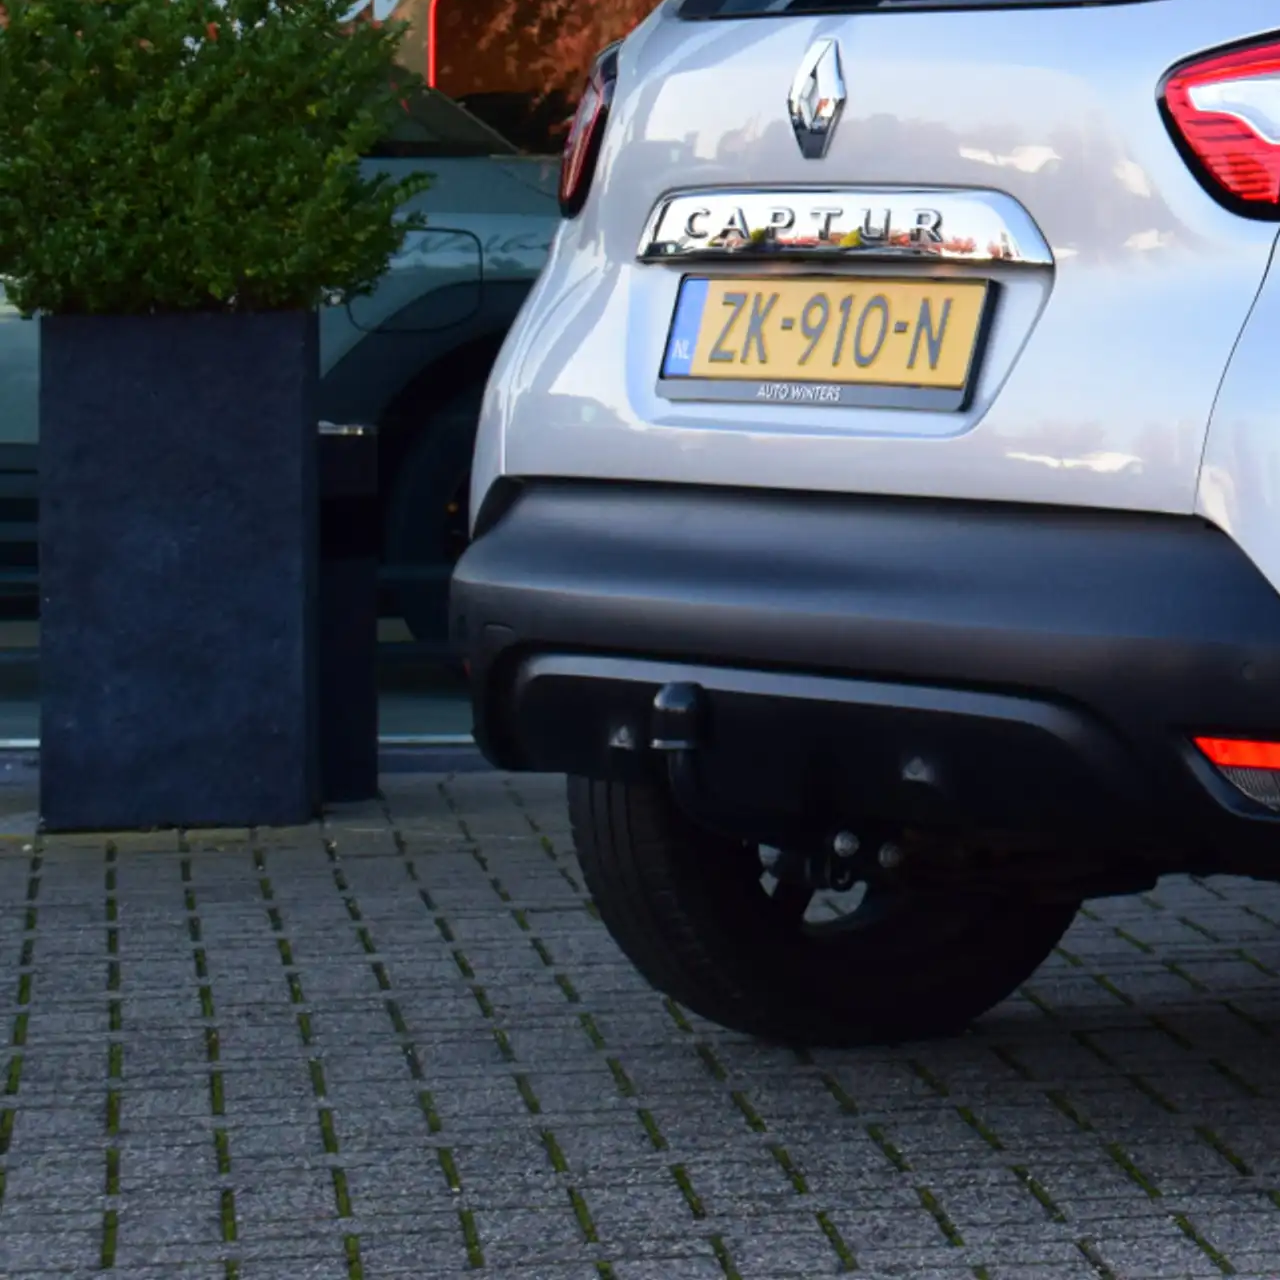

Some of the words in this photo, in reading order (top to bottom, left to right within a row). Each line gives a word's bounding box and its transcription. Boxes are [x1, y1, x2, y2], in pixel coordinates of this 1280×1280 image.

[684, 207, 944, 243] CAPTUR
[671, 338, 691, 360] NL
[708, 291, 954, 371] ZK-910-N
[757, 384, 788, 400] AUTO
[791, 385, 841, 402] WINTERS
